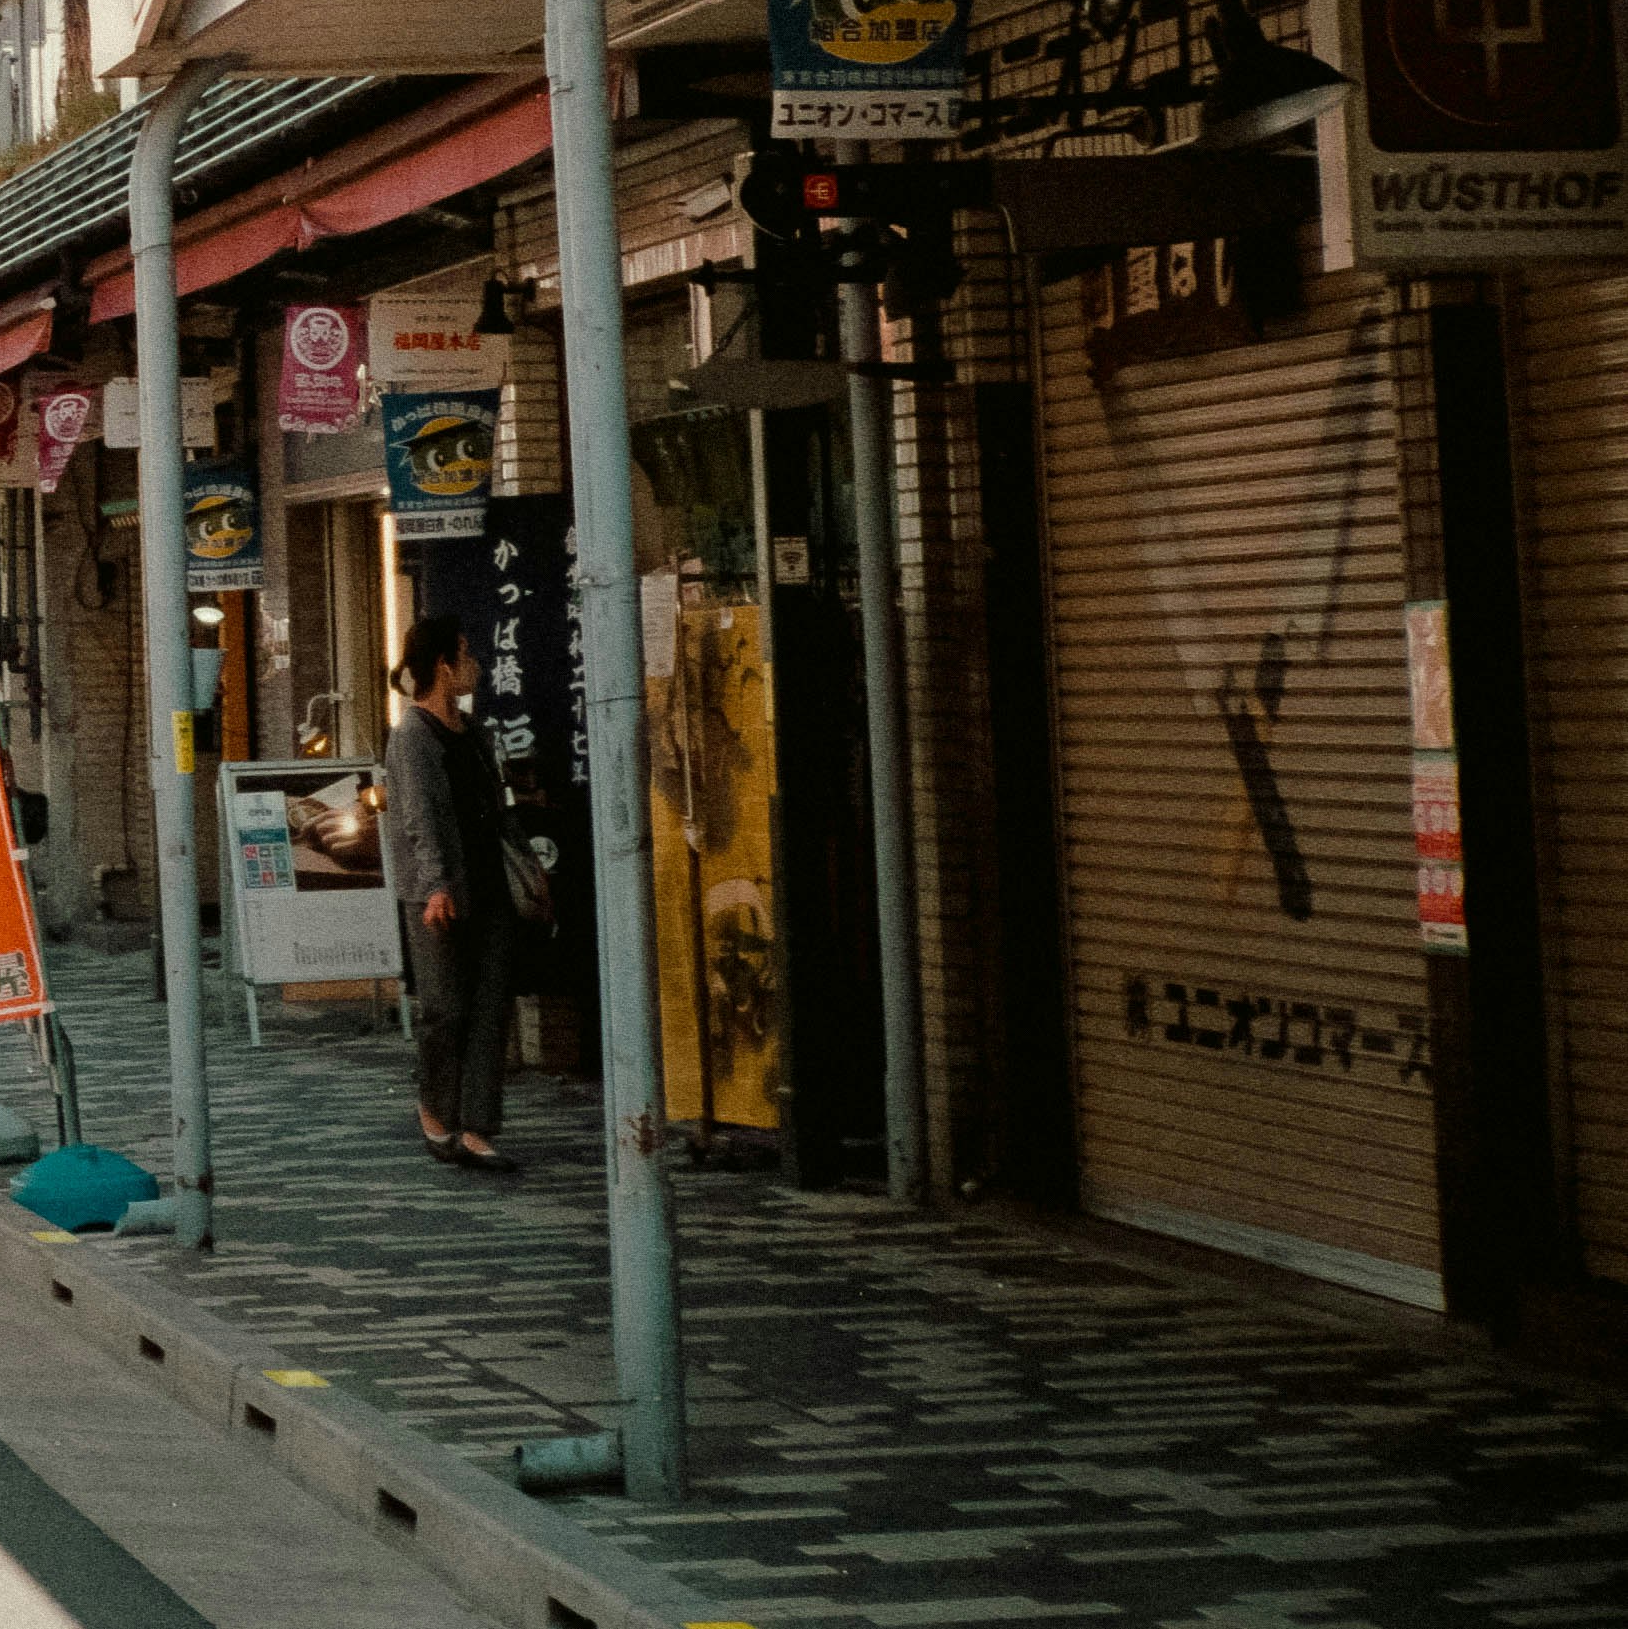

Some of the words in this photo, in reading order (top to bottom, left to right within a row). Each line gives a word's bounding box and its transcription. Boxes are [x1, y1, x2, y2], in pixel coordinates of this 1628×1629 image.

[810, 19, 945, 43] 組合加盟店
[779, 102, 942, 128] ユニオン・コマース
[1372, 163, 1624, 211] WÜSTHOF
[393, 332, 481, 352] 福岡屋本店
